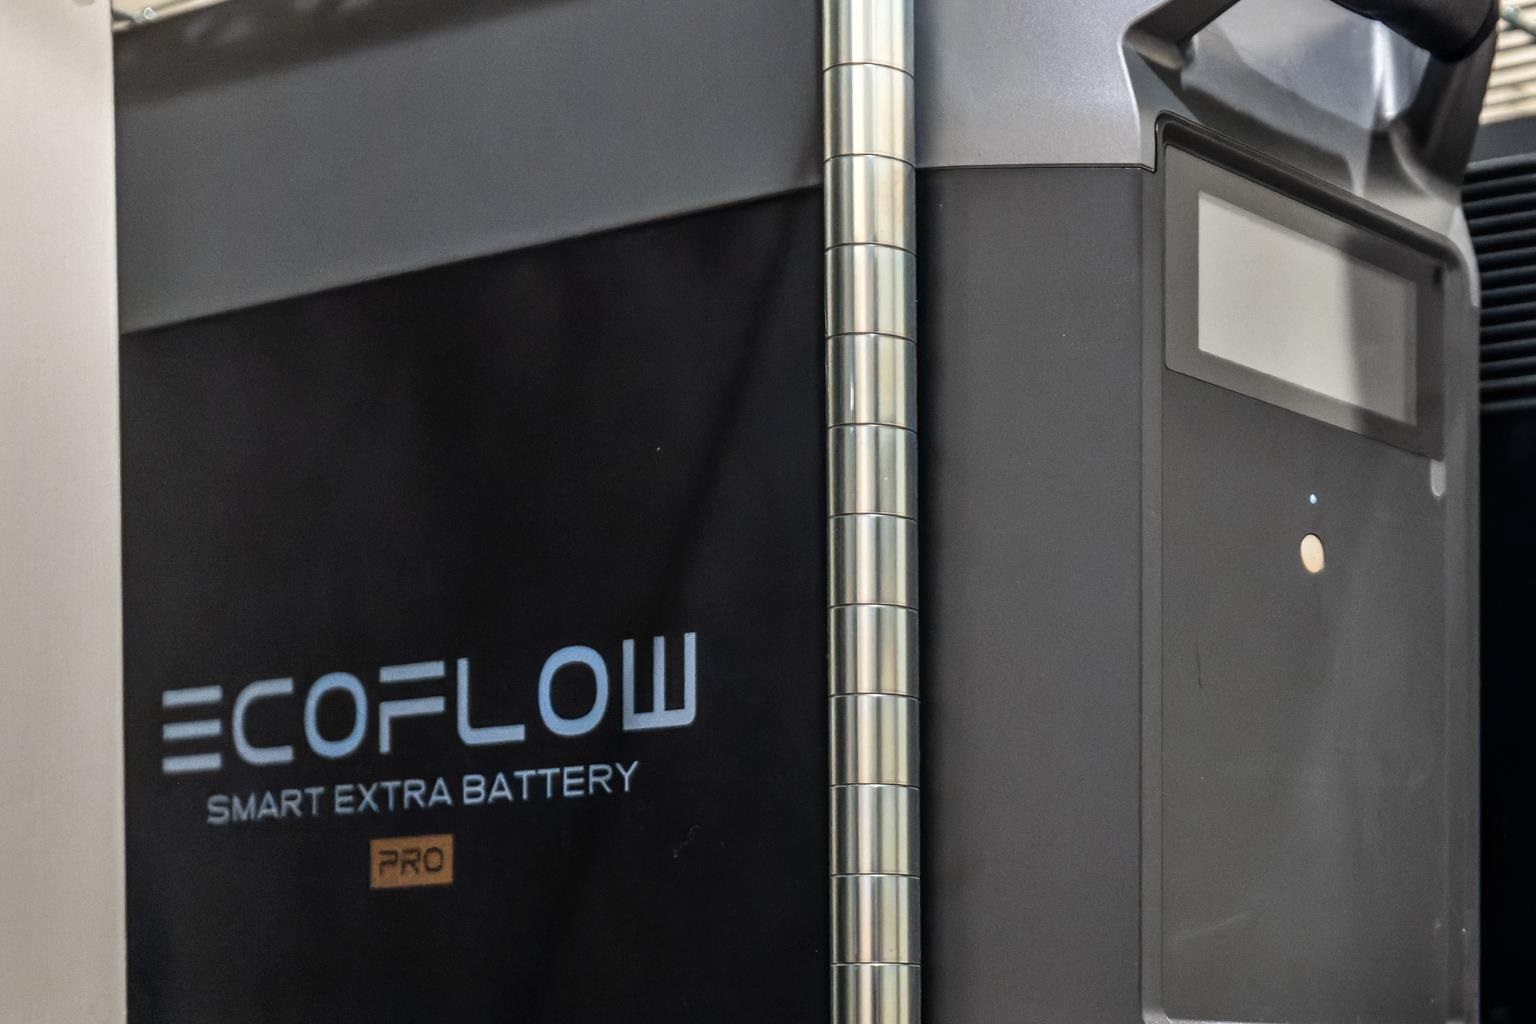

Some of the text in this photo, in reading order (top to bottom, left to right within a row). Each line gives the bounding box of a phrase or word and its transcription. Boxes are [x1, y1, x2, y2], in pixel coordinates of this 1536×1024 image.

[162, 631, 698, 774] ECOFLOW
[207, 760, 640, 825] SMART EXTRA BATTERY
[377, 845, 446, 877] PRO
